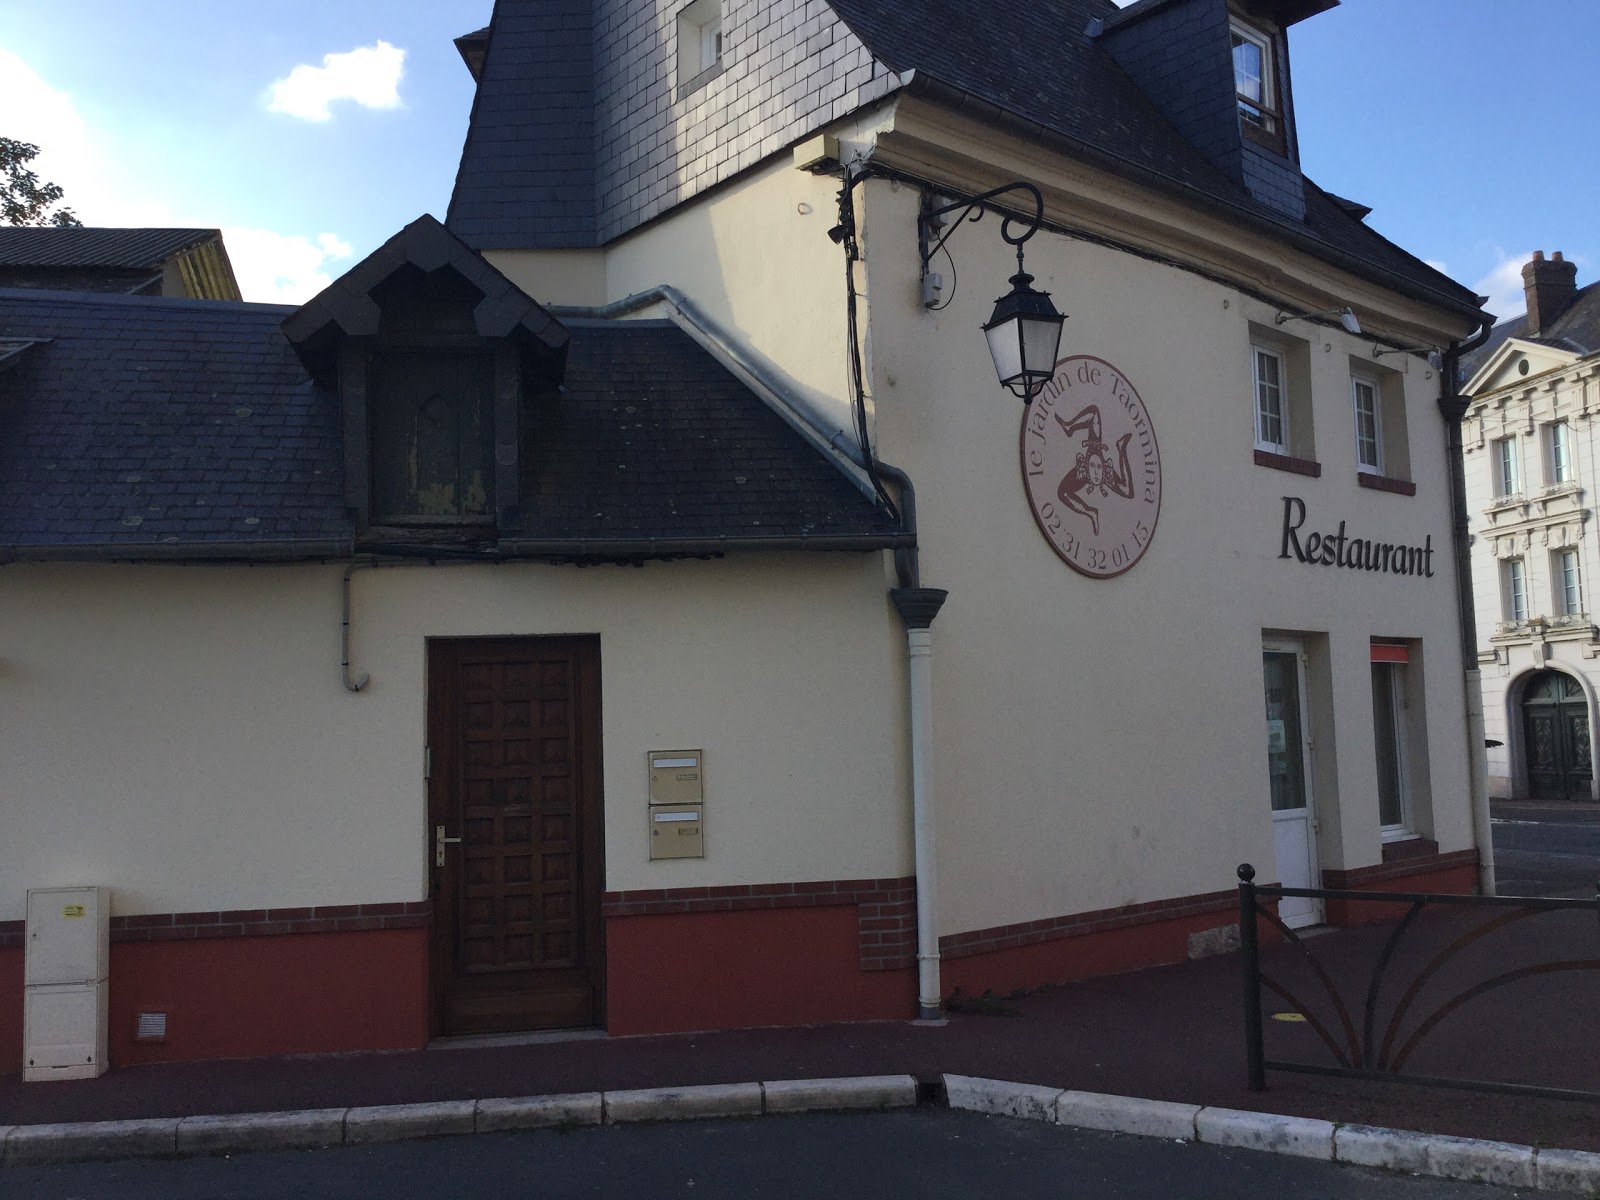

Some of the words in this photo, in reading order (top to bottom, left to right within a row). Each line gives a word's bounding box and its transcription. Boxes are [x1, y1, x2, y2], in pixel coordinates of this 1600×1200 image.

[1078, 361, 1101, 385] de
[1028, 372, 1072, 445] jardin
[1110, 373, 1157, 504] Taormina
[1028, 451, 1044, 477] le
[1041, 502, 1061, 535] 02
[1061, 531, 1080, 559] 31
[1087, 548, 1107, 570] 32
[1112, 544, 1130, 567] 01
[1131, 520, 1149, 547] 15
[1277, 495, 1434, 578] Restaurant
